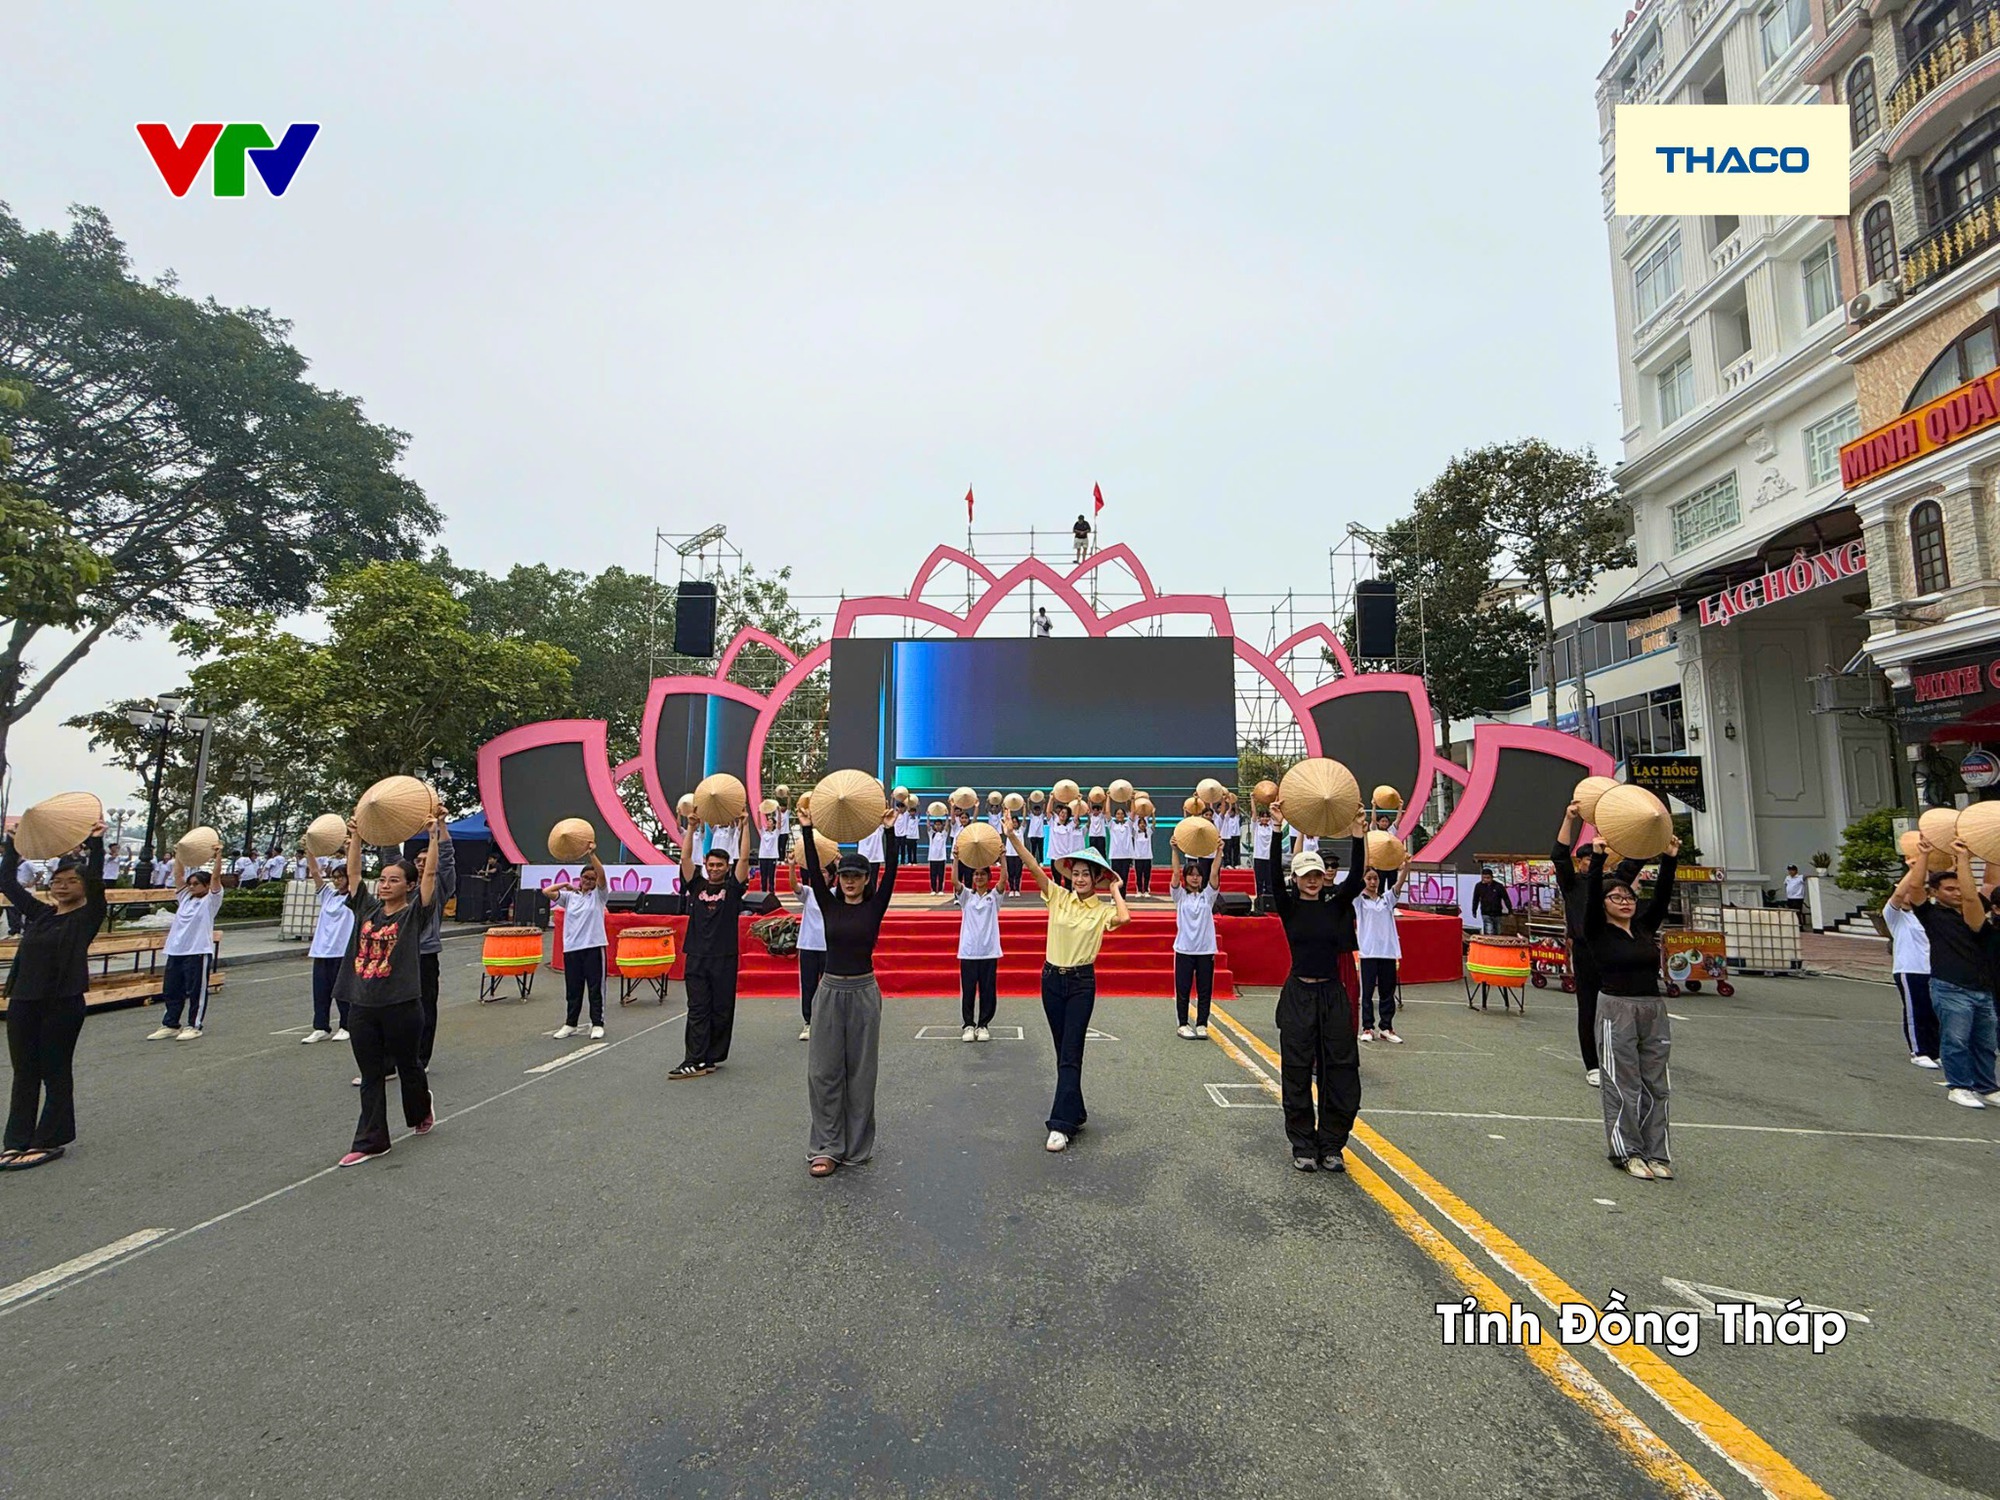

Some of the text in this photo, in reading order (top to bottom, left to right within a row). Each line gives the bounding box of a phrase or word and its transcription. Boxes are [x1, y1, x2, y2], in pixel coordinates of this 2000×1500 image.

[1841, 377, 2000, 484] MINH QUÂ
[1698, 537, 1868, 627] LẠC HỒNG
[1627, 605, 1681, 640] RESTAURANT
[1642, 631, 1669, 654] HOTEL
[1914, 664, 1983, 702] MINH
[1633, 760, 1699, 778] LẠC HỒNG
